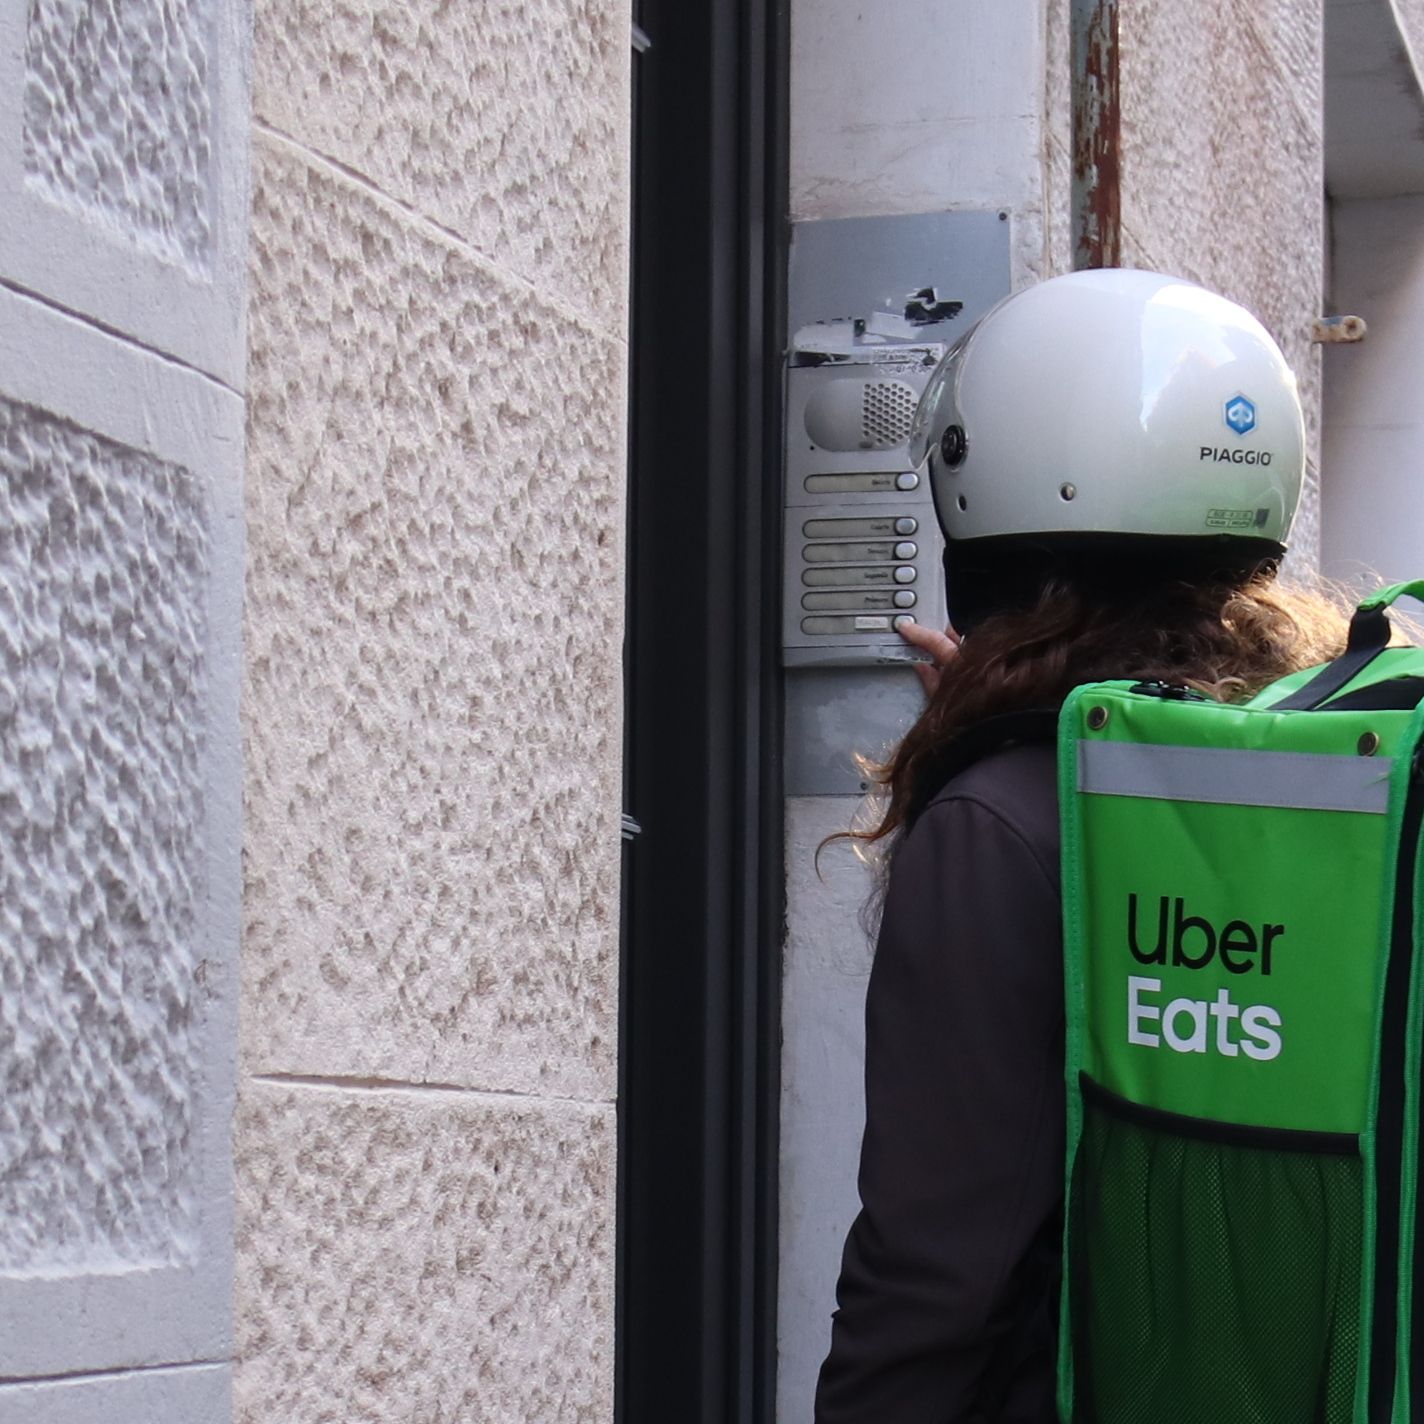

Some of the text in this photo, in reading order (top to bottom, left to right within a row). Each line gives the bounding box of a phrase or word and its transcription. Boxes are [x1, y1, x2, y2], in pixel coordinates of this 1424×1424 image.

[1199, 446, 1273, 467] PIAGGIO
[1127, 892, 1285, 976] Uber
[1127, 975, 1283, 1061] Eats
